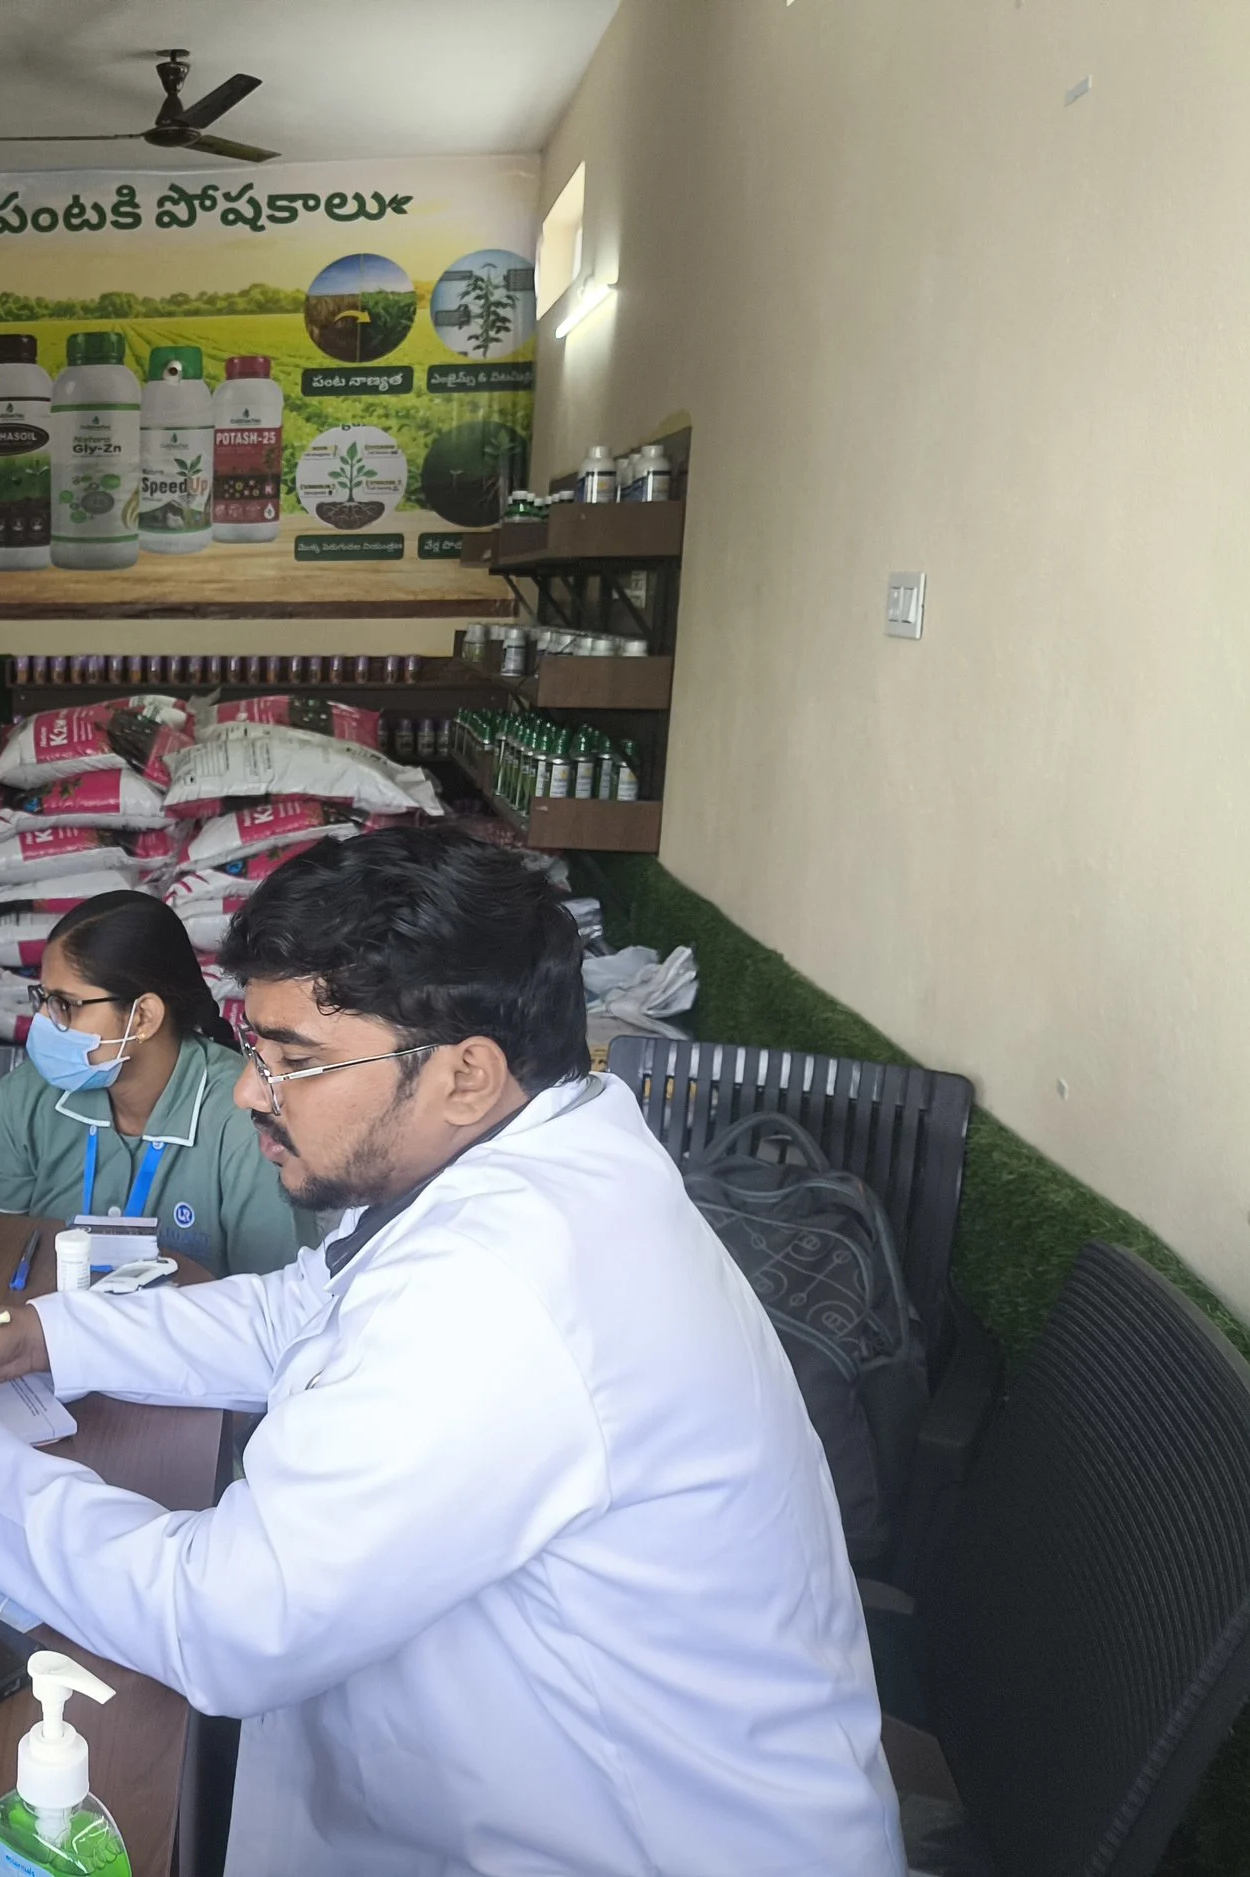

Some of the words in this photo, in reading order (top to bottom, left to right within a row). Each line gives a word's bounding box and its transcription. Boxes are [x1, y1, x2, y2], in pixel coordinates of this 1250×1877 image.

[155, 182, 390, 233] పోషకాలు
[312, 375, 346, 389] పంట
[349, 371, 404, 392] నాణ్యత
[215, 431, 277, 445] POTASH-25
[72, 444, 122, 455] Gly-Zn
